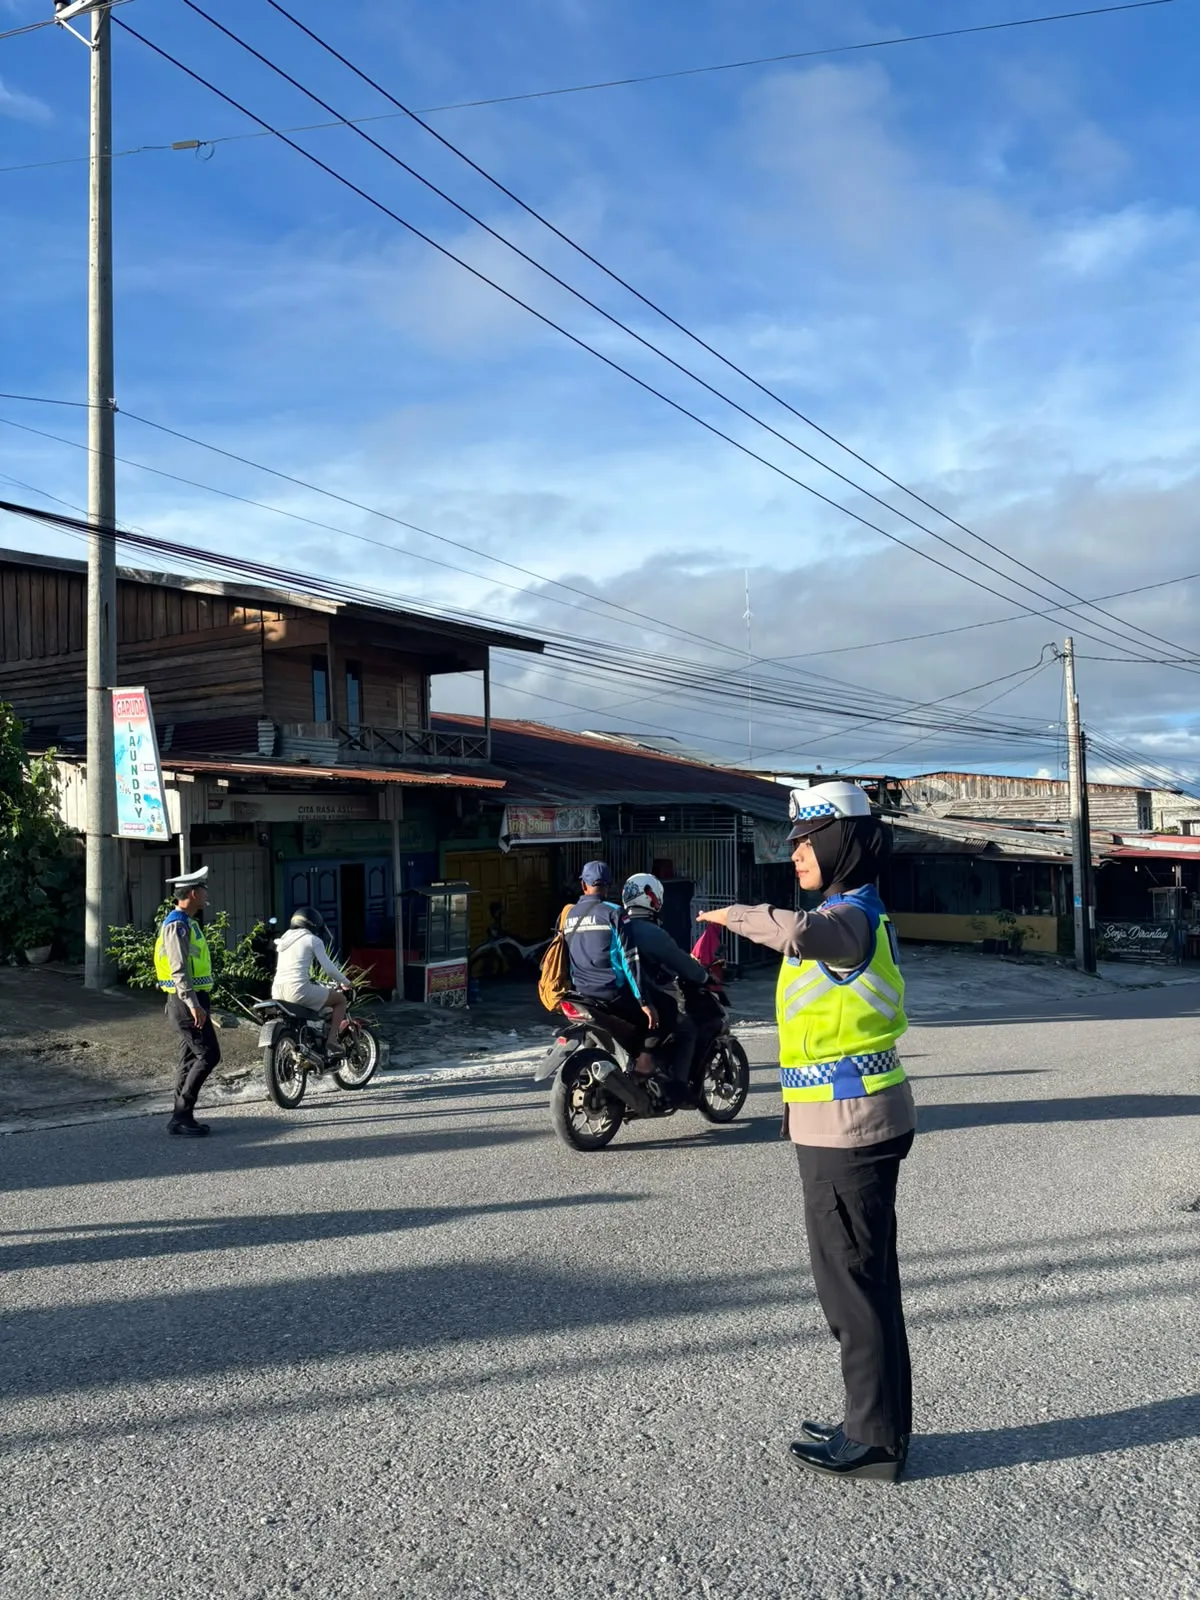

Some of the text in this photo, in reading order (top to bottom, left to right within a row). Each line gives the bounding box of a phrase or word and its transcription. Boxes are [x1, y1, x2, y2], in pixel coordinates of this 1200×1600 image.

[116, 699, 146, 717] GARUDA
[127, 721, 143, 819] LAUNDRY
[298, 805, 314, 814] CITA
[316, 805, 336, 814] RASA
